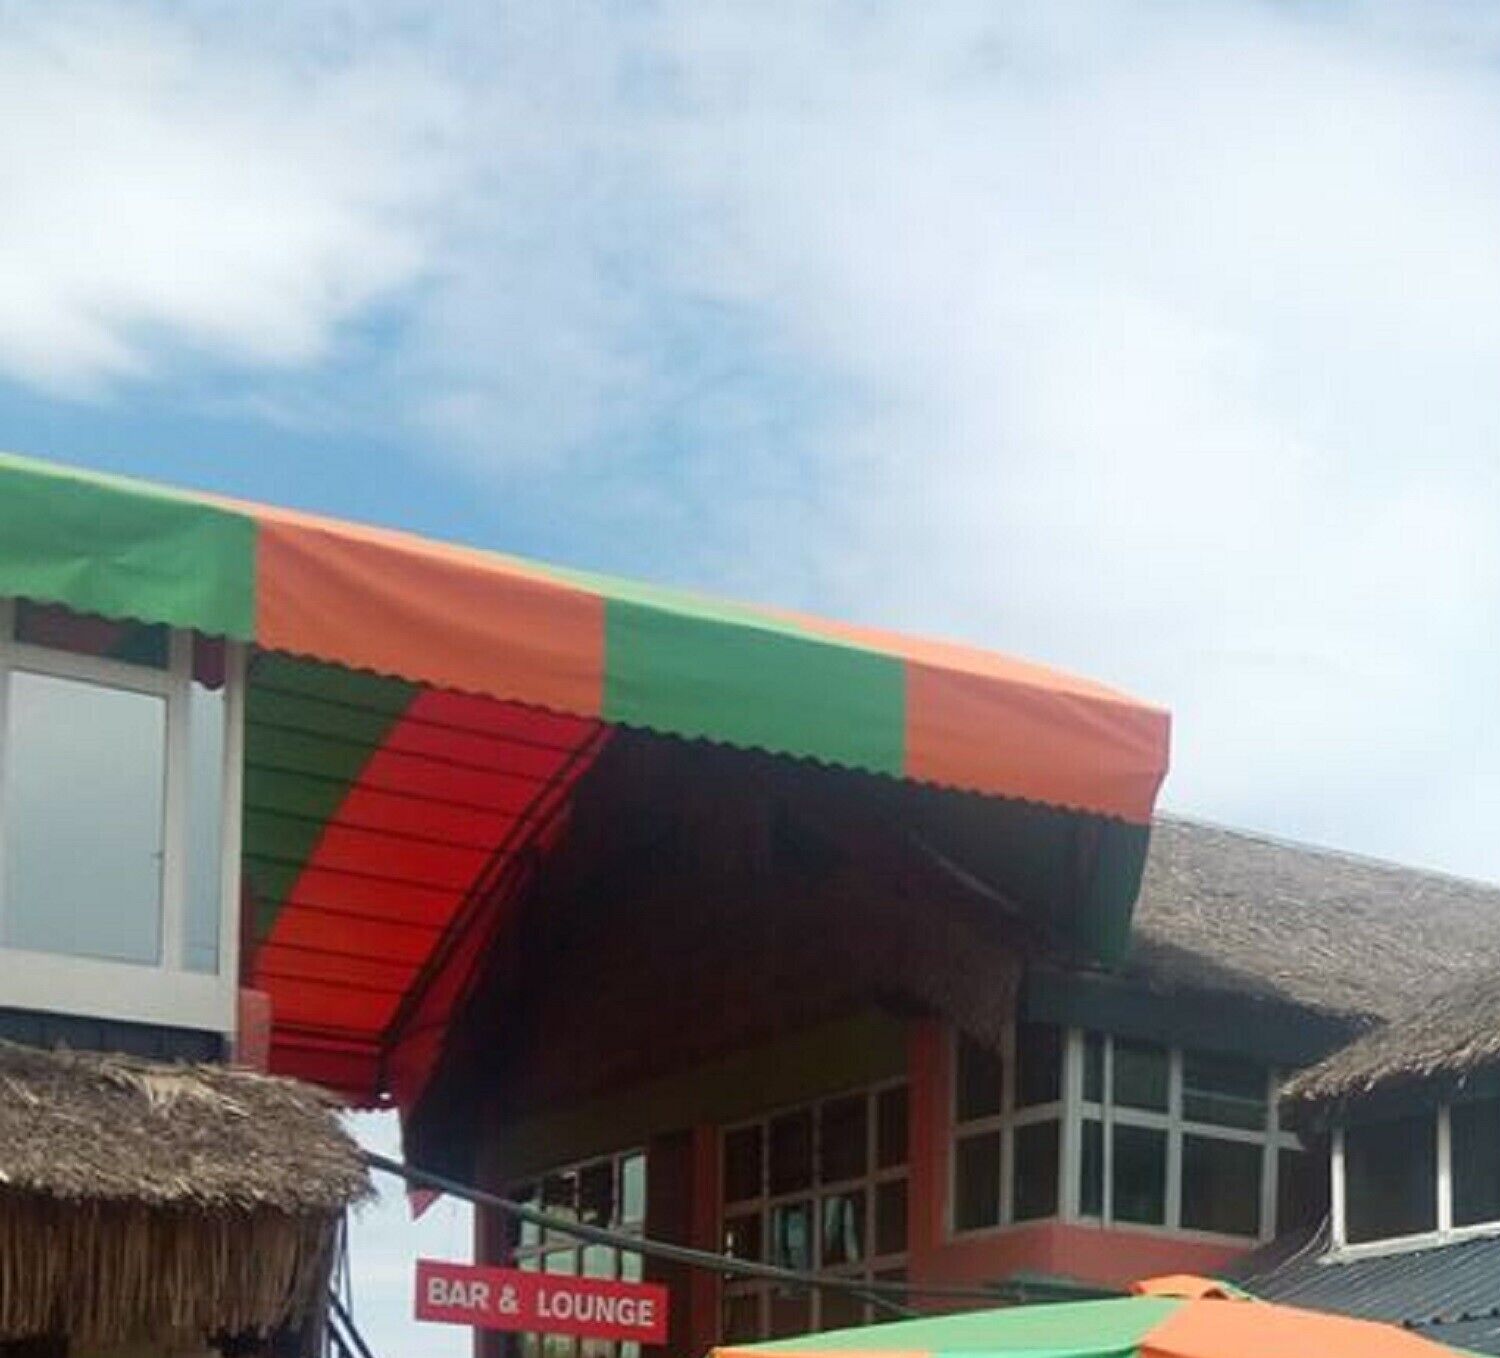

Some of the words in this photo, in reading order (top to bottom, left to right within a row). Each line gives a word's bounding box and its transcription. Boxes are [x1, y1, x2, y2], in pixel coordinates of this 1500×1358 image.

[427, 1277, 488, 1309] BAR
[499, 1285, 518, 1314] &
[537, 1288, 654, 1327] LOUNGE
